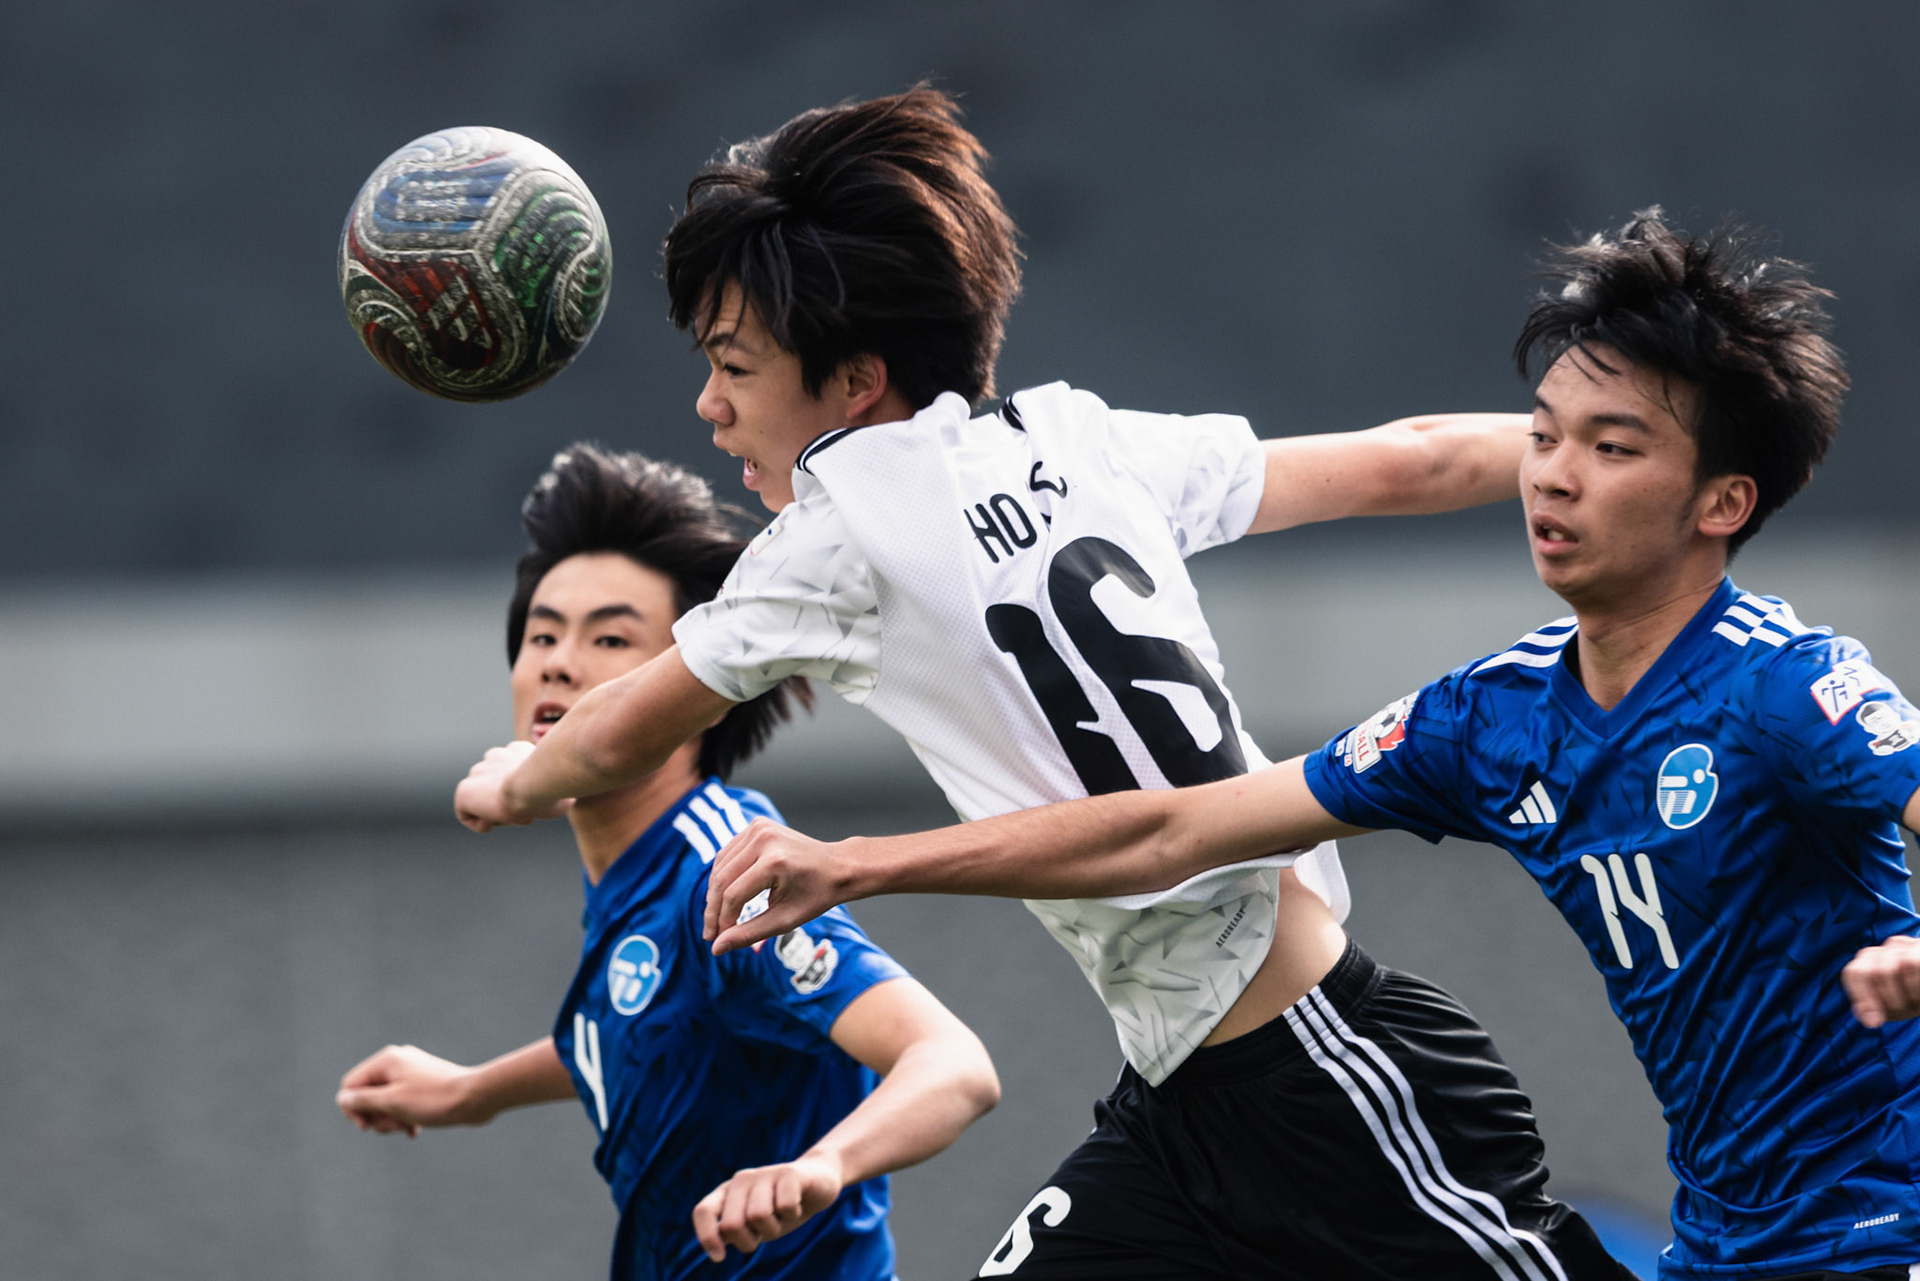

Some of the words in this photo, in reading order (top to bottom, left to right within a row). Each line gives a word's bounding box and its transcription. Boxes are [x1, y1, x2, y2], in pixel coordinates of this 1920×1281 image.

[984, 536, 1249, 797] 16
[1215, 907, 1246, 949] AEROREADY
[1580, 852, 1680, 970] 14
[1853, 1212, 1900, 1230] AEROREADY
